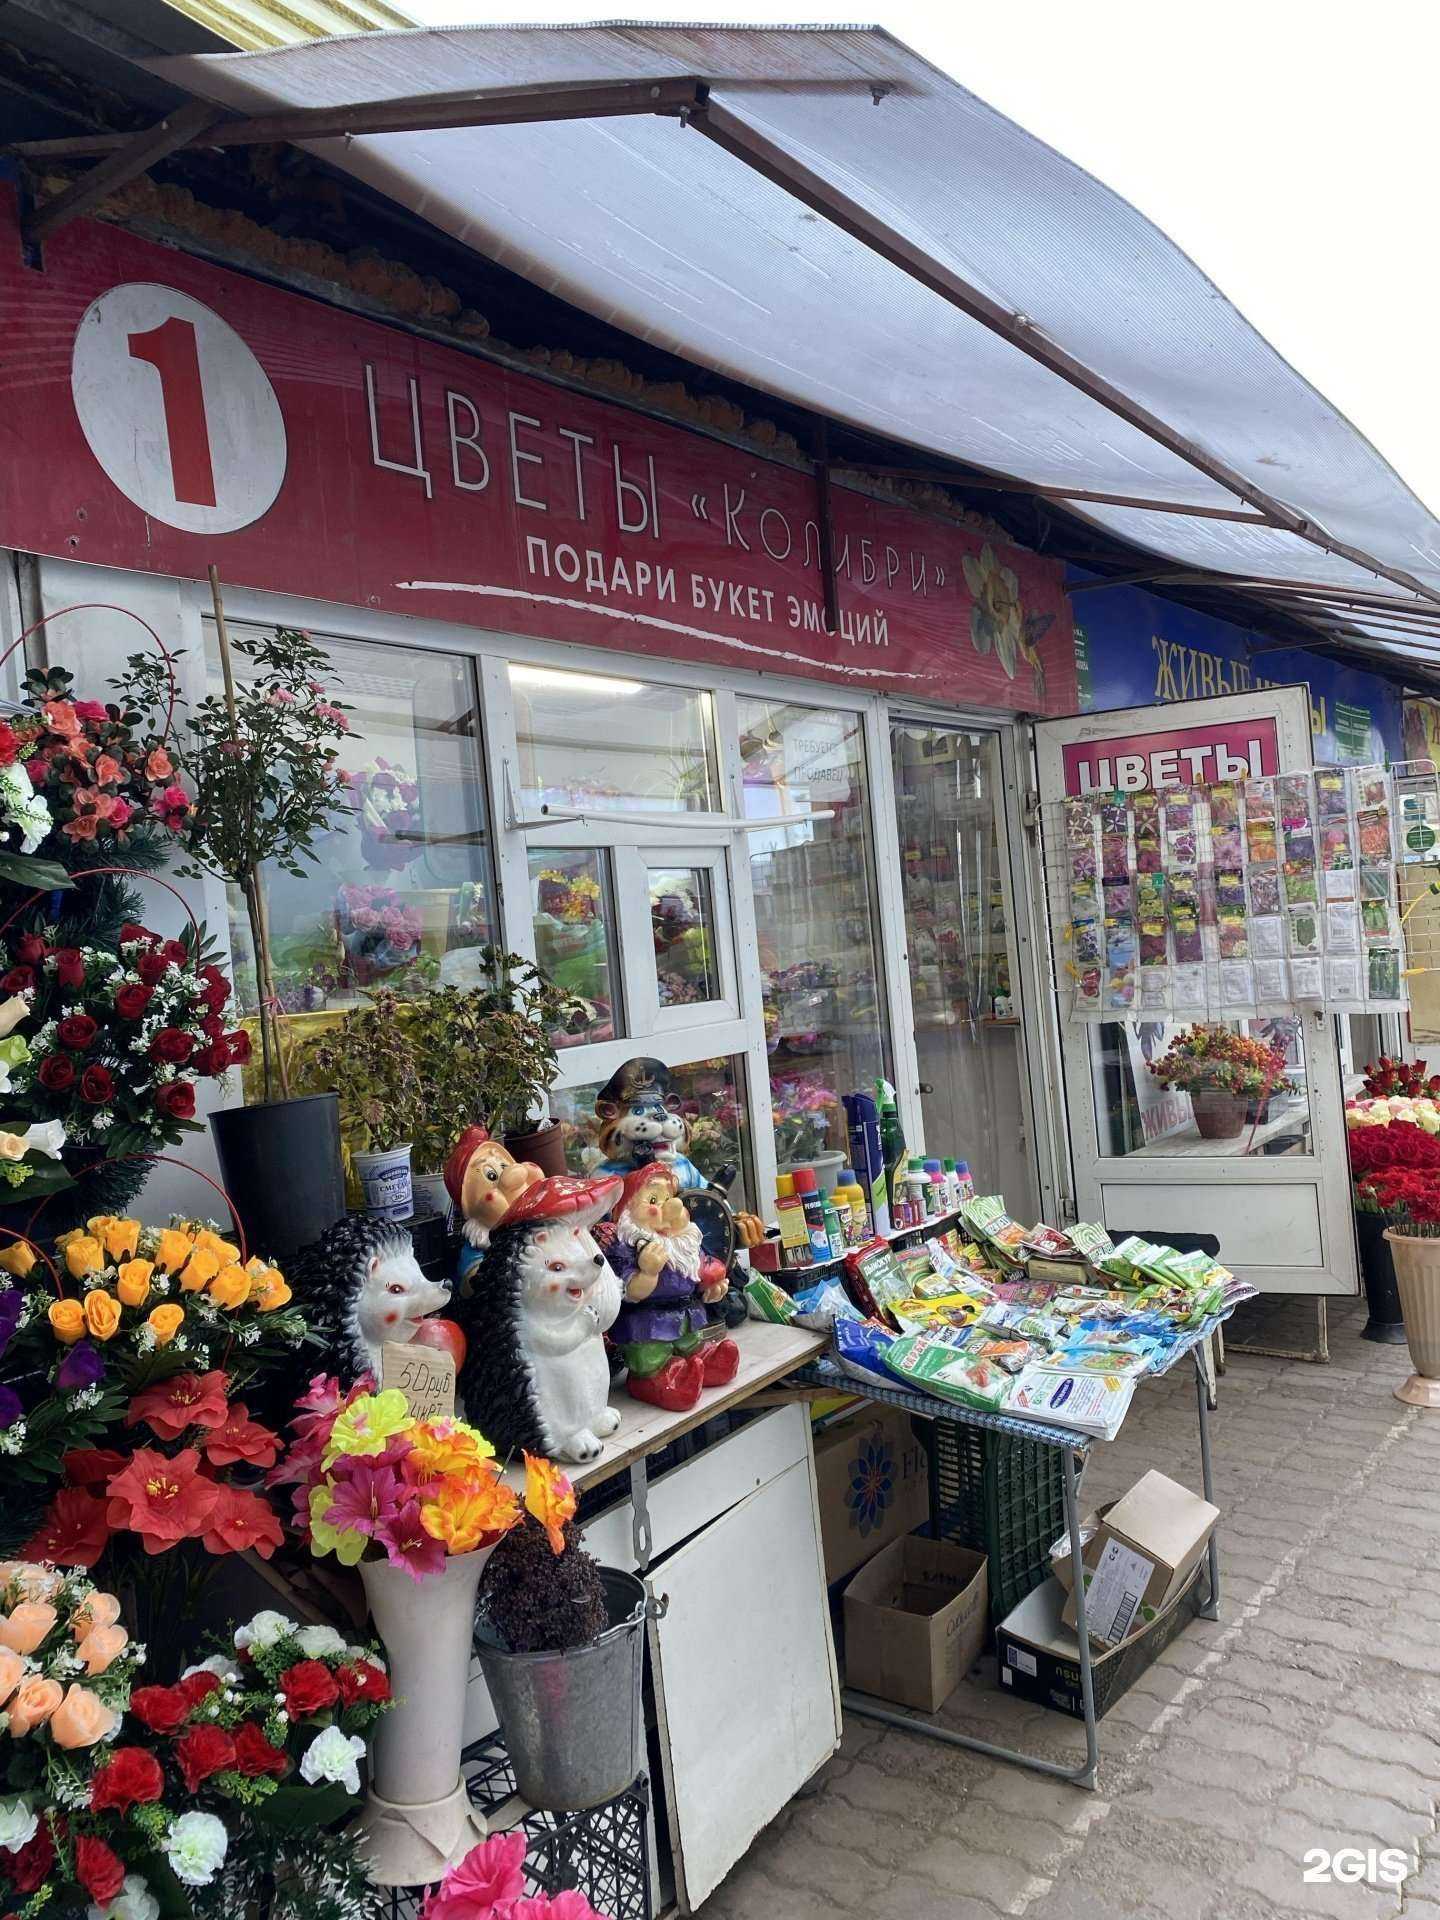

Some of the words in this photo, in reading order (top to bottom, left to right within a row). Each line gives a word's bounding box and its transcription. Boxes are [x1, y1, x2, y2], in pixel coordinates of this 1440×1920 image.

[127, 316, 217, 508] 1
[364, 362, 659, 539] ЦВЕТЫ
[526, 536, 677, 604] ПОДАРИ
[691, 573, 775, 623] БУКЕТ
[1078, 738, 1263, 796] ЦВЕТЫ
